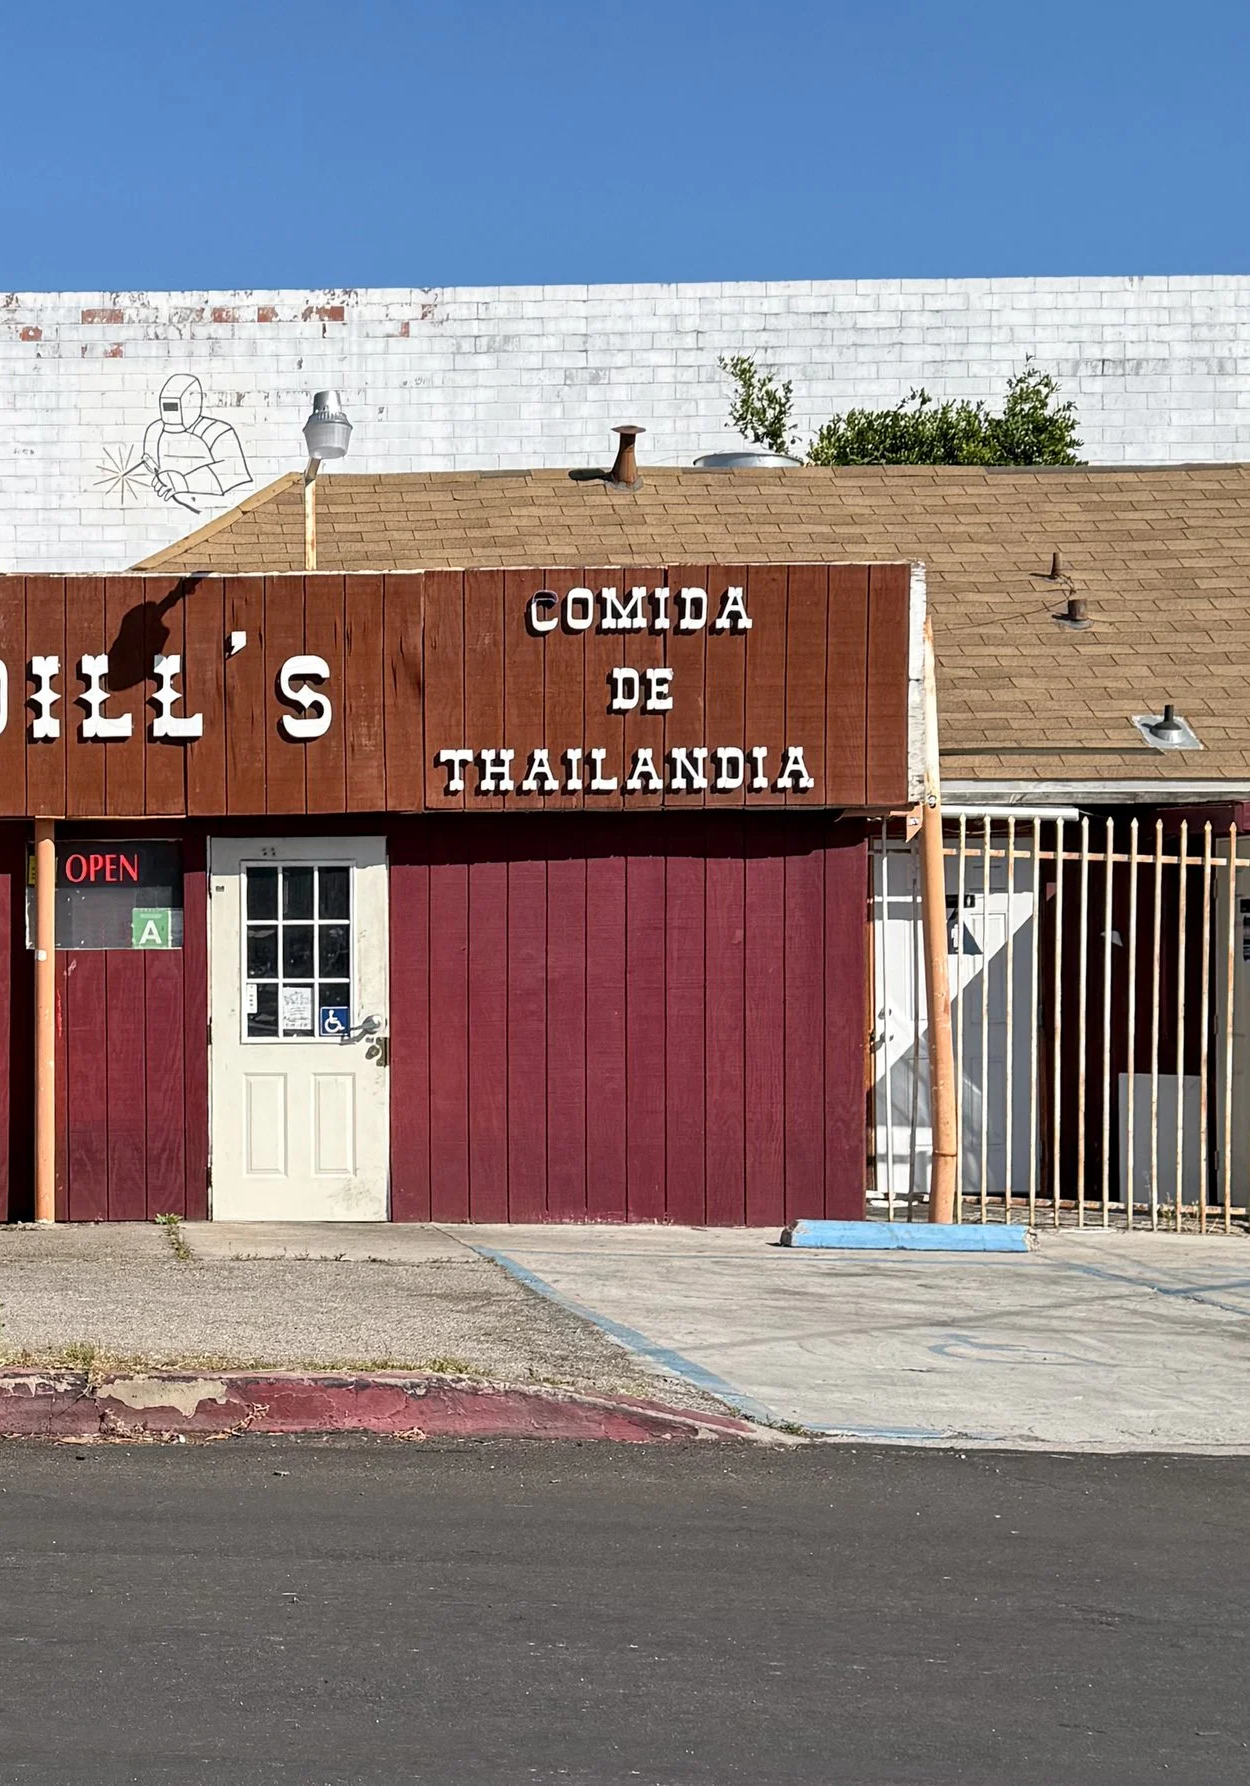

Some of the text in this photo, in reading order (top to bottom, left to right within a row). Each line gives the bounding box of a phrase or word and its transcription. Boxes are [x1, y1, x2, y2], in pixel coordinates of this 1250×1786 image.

[530, 586, 753, 632] COMIDA
[612, 667, 674, 710] DE
[440, 746, 814, 791] THAILANDIA
[65, 854, 138, 882] OPEN
[139, 919, 162, 945] A
